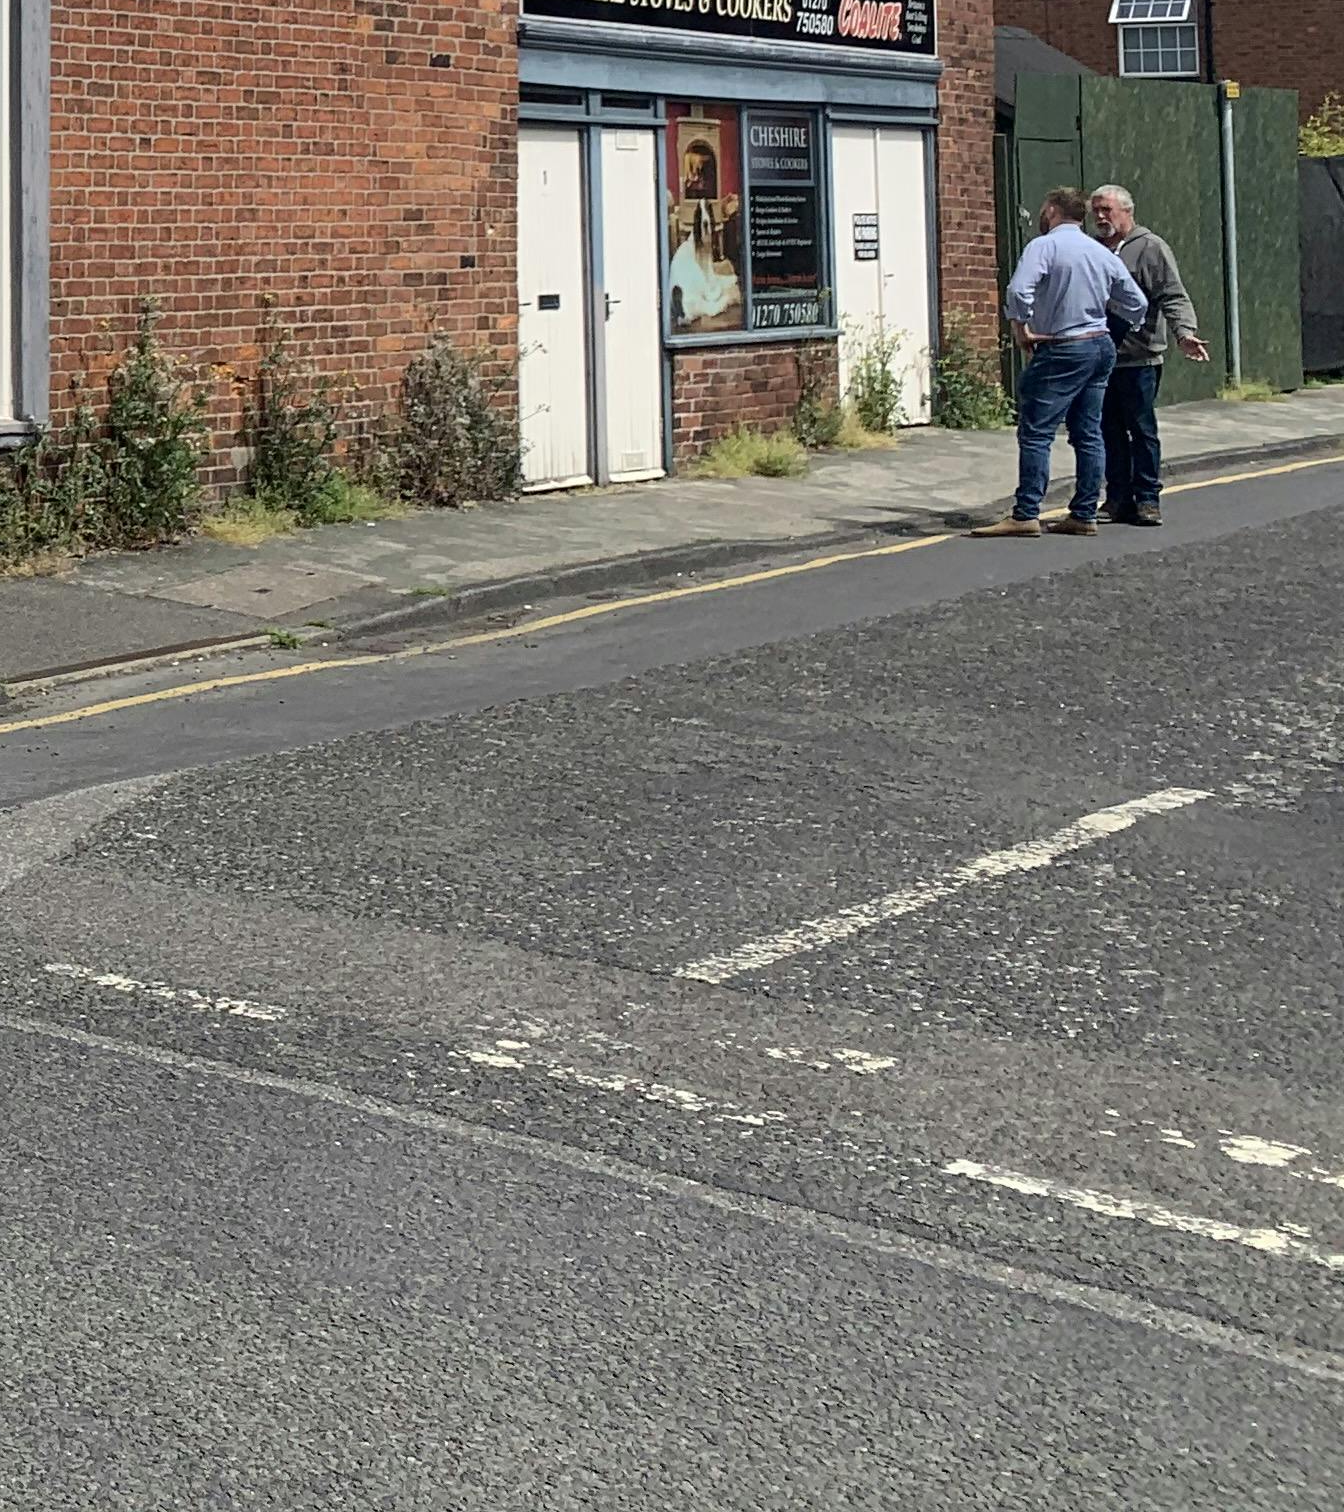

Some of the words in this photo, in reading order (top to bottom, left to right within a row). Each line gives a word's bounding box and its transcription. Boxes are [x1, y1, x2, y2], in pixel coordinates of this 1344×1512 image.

[796, 12, 833, 36] 750580
[751, 126, 807, 147] CHESHIRE
[784, 302, 819, 324] 750580
